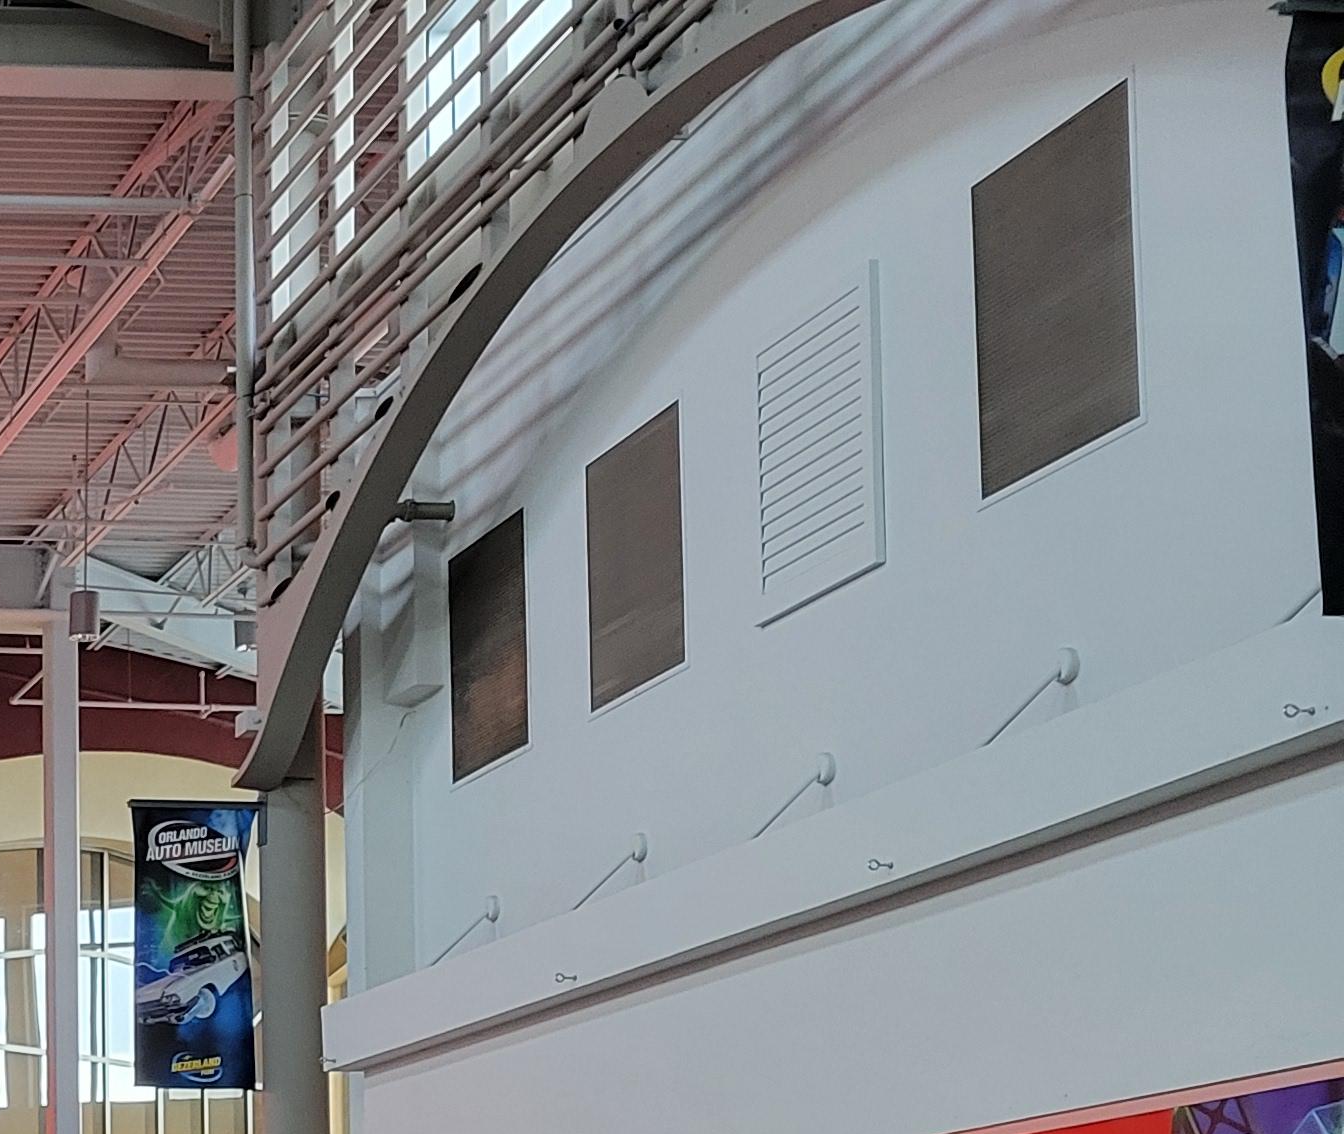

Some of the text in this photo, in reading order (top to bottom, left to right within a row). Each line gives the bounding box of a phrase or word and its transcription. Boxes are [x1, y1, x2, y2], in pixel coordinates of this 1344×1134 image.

[158, 827, 208, 843] ORLANDO
[146, 843, 182, 861] AUTO
[171, 1056, 222, 1073] DEZERLAND
